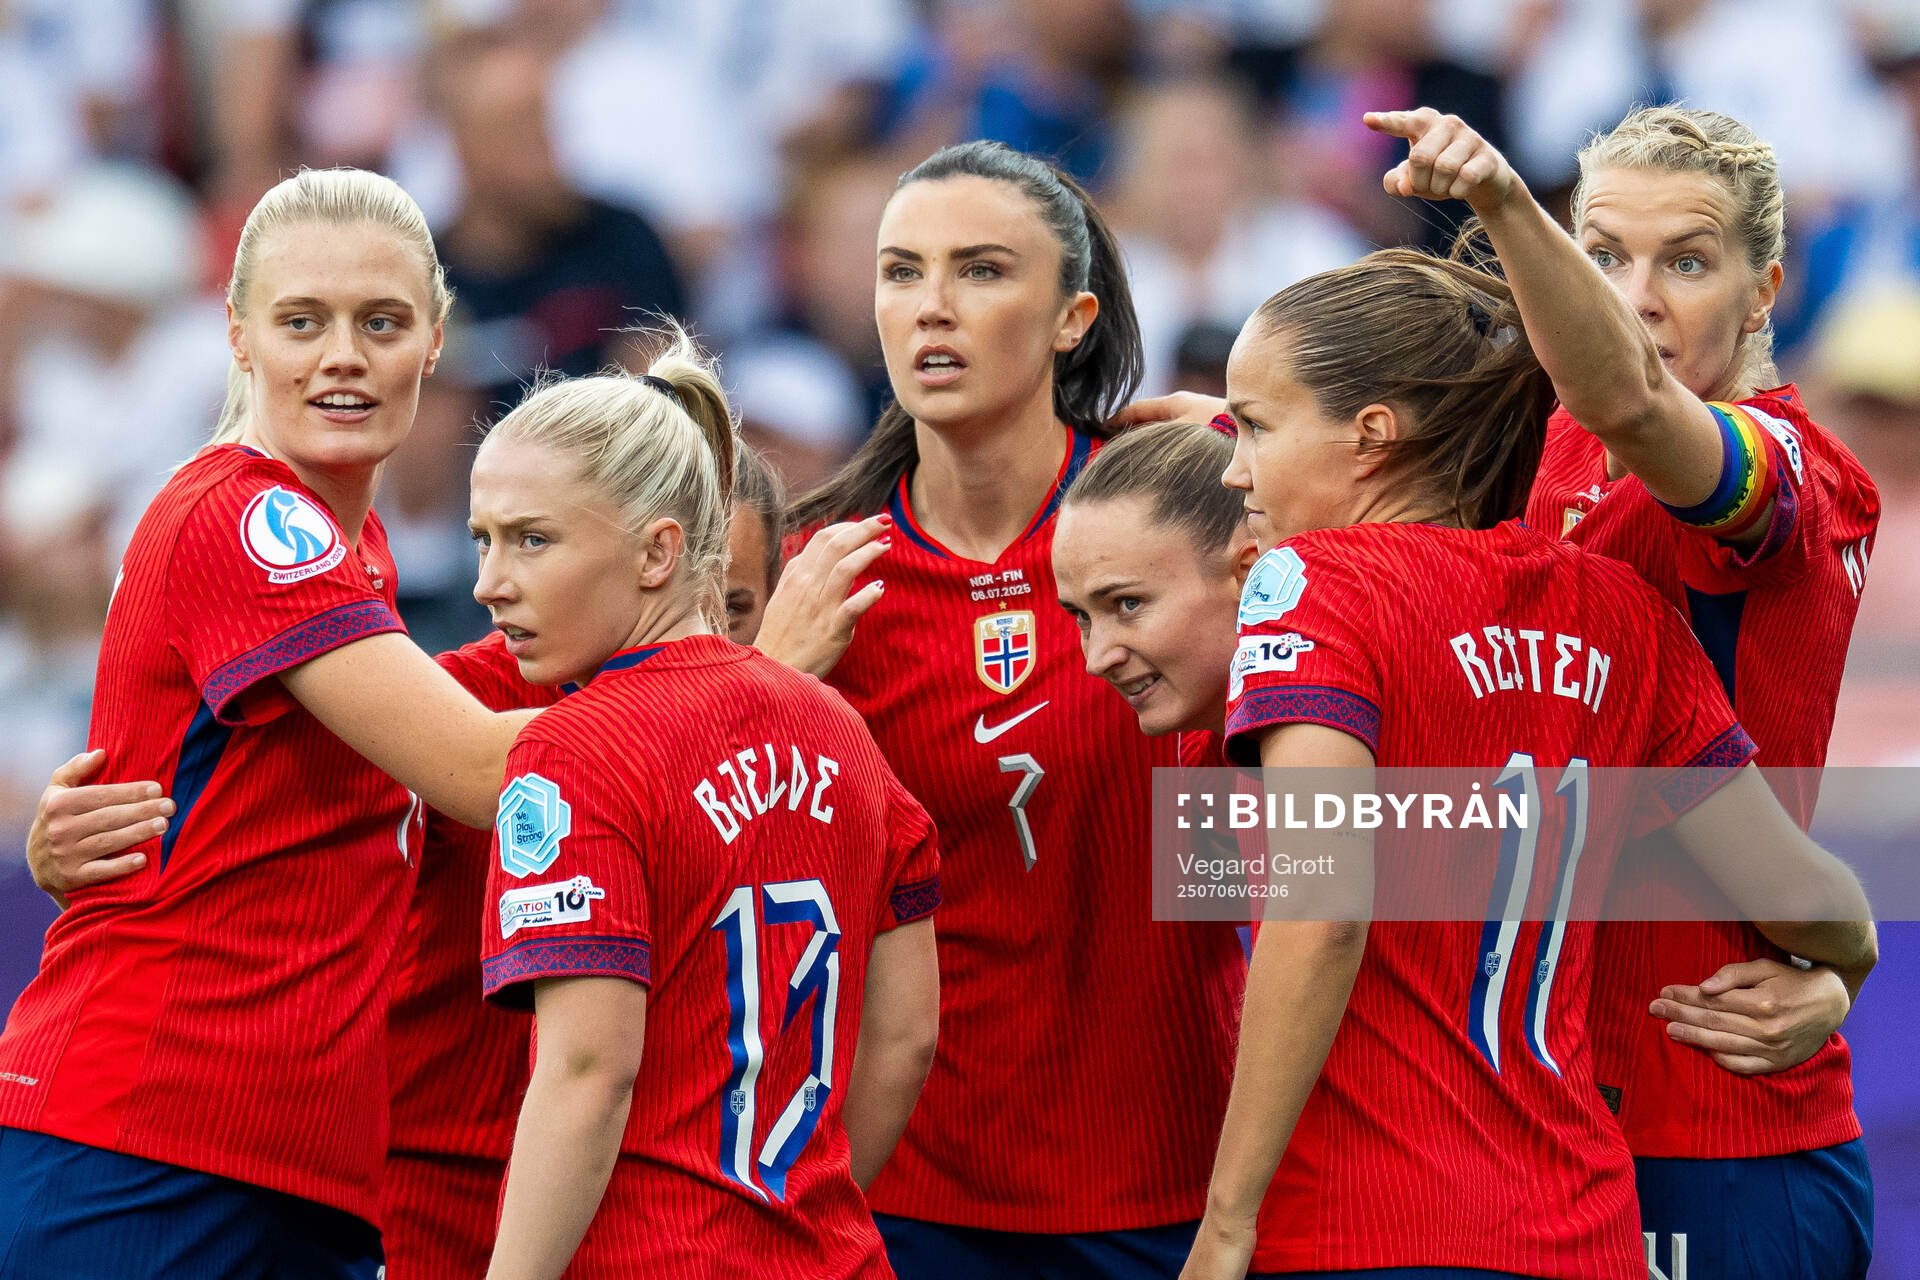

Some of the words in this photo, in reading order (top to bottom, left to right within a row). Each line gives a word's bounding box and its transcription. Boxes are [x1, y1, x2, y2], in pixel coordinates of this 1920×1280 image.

[272, 560, 332, 580] SWITZERLAND
[330, 546, 344, 562] 2025
[969, 574, 994, 587] NOR
[1002, 569, 1023, 582] FIN
[971, 583, 1031, 601] 06.07.2025
[1449, 625, 1611, 714] REITEN
[693, 743, 839, 845] BJELDE
[516, 811, 527, 821] We
[998, 753, 1045, 873] 7
[516, 823, 533, 833] Play
[516, 831, 543, 844] Strong
[554, 889, 586, 912] 10
[1468, 751, 1589, 1079] 11
[711, 878, 842, 1203] 13
